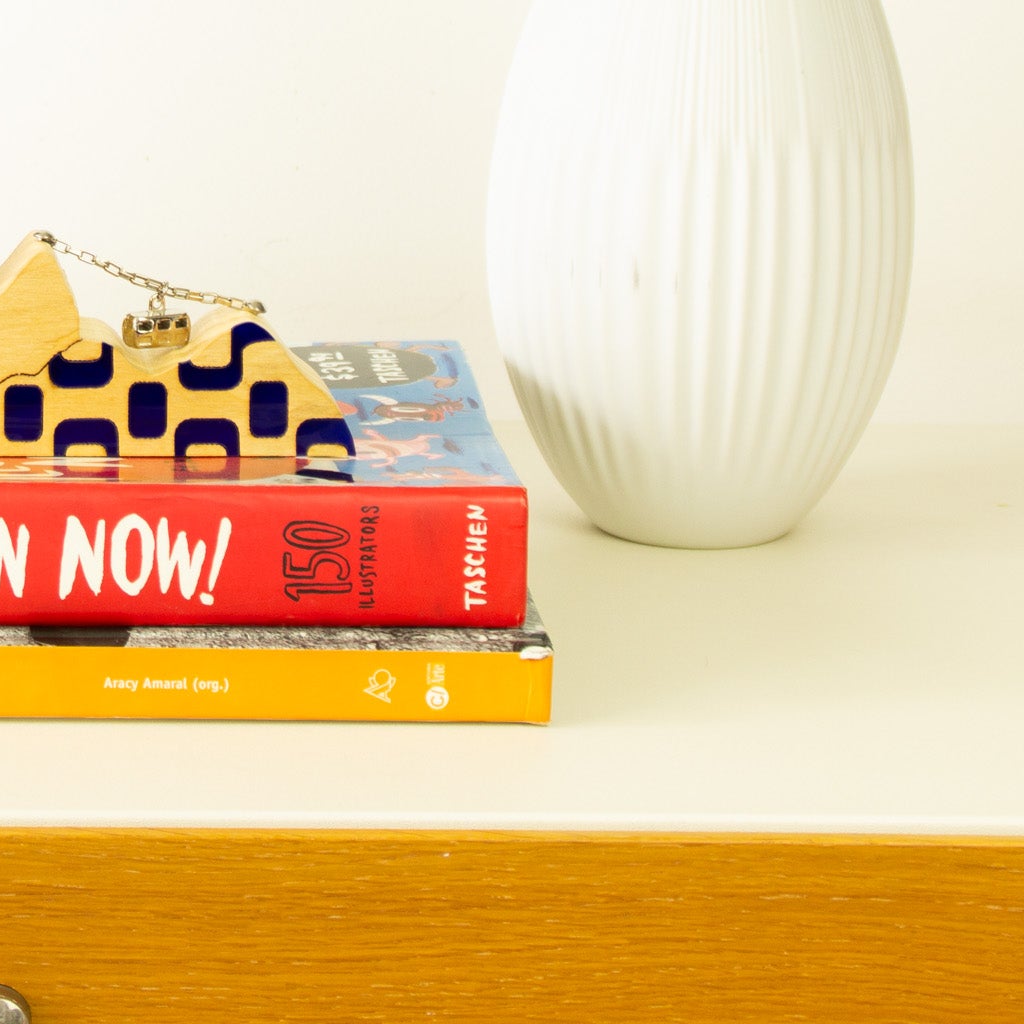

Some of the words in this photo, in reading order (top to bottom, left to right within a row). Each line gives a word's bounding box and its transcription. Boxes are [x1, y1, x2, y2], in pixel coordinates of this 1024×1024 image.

[368, 349, 410, 384] TASCHEN
[59, 513, 231, 605] NOW!
[283, 521, 352, 602] 150
[358, 505, 380, 609] ILLUSTRATORS
[464, 504, 488, 611] TASCHEN
[103, 677, 139, 692] Aracy
[143, 677, 187, 690] Amaral
[192, 677, 229, 693] (org.)
